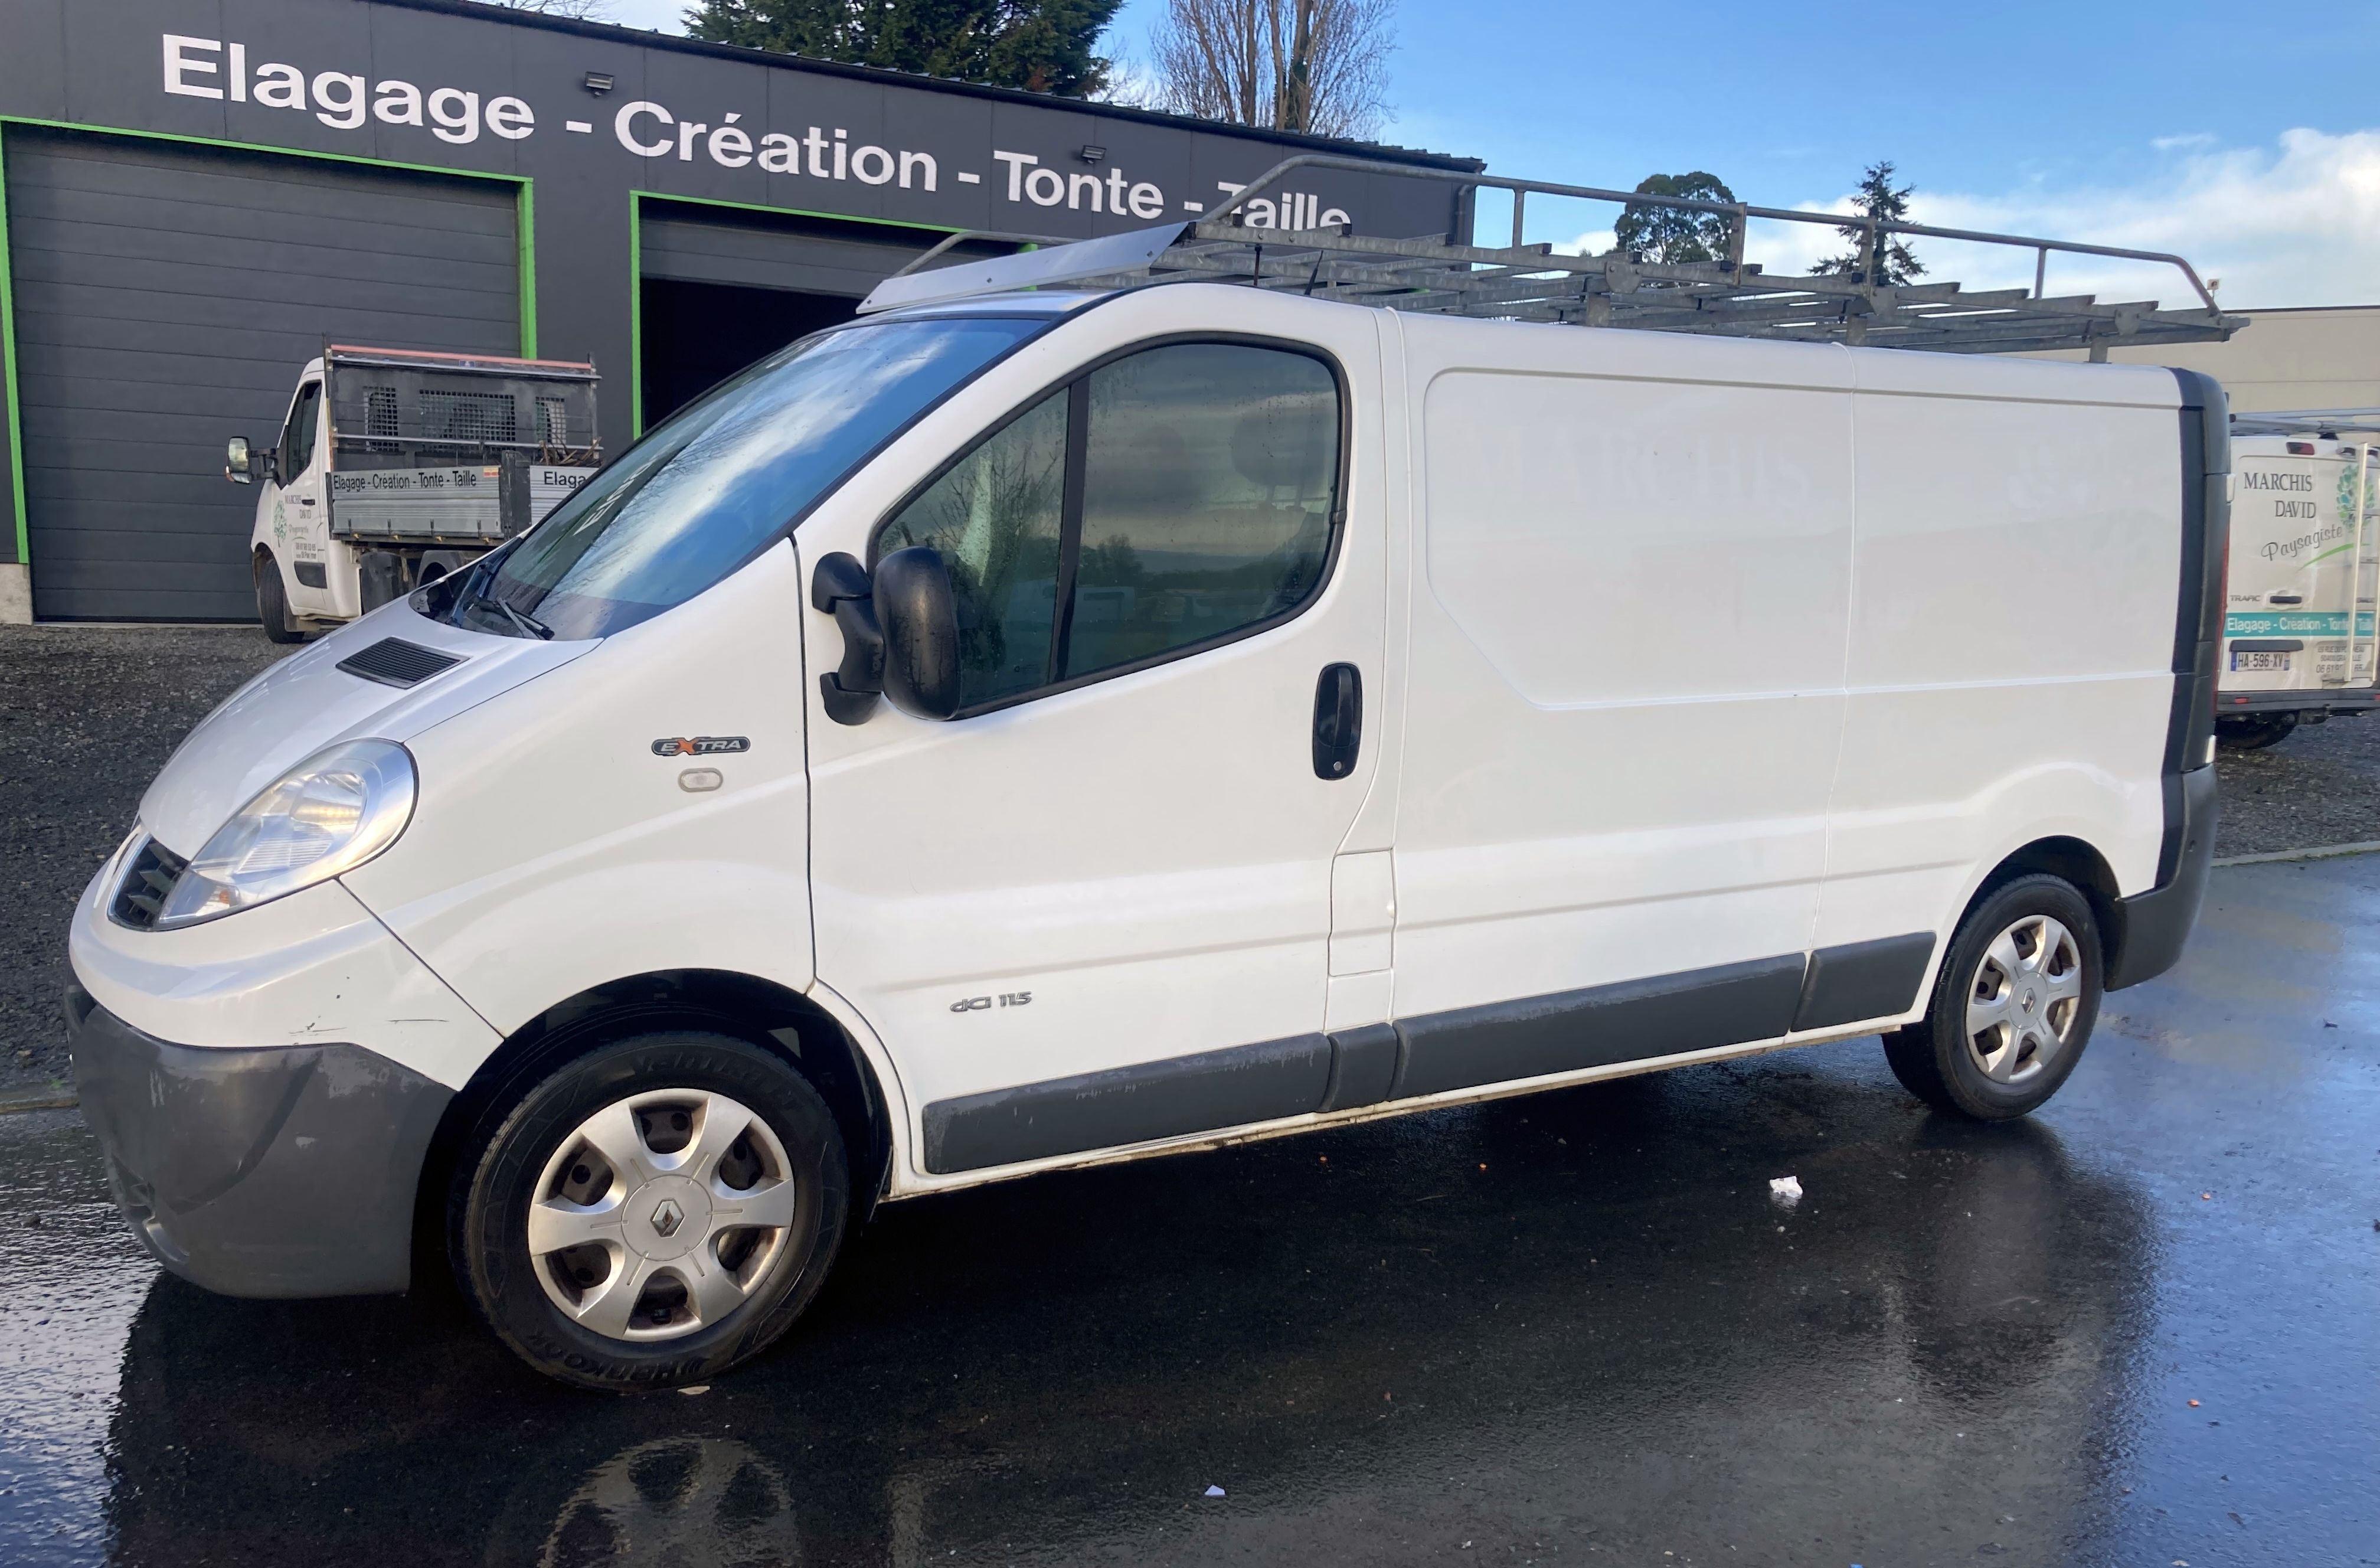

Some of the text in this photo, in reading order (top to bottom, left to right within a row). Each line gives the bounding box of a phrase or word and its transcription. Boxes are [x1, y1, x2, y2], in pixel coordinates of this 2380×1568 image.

[162, 34, 535, 144] Elagage
[614, 101, 937, 192] Création
[993, 150, 1164, 219] Tonte
[1218, 181, 1351, 231] Taille
[334, 475, 365, 492] Elagage
[372, 472, 410, 489] Création
[418, 472, 444, 488] Tonte
[452, 470, 476, 487] Taille
[2243, 472, 2313, 492] MARCHIS
[2274, 500, 2317, 519] DAVID
[2260, 524, 2343, 562] Paysagiste
[2227, 617, 2271, 633] Elagage
[2279, 617, 2321, 631] Création
[661, 737, 742, 755] EXTRA
[998, 991, 1032, 1008] 115
